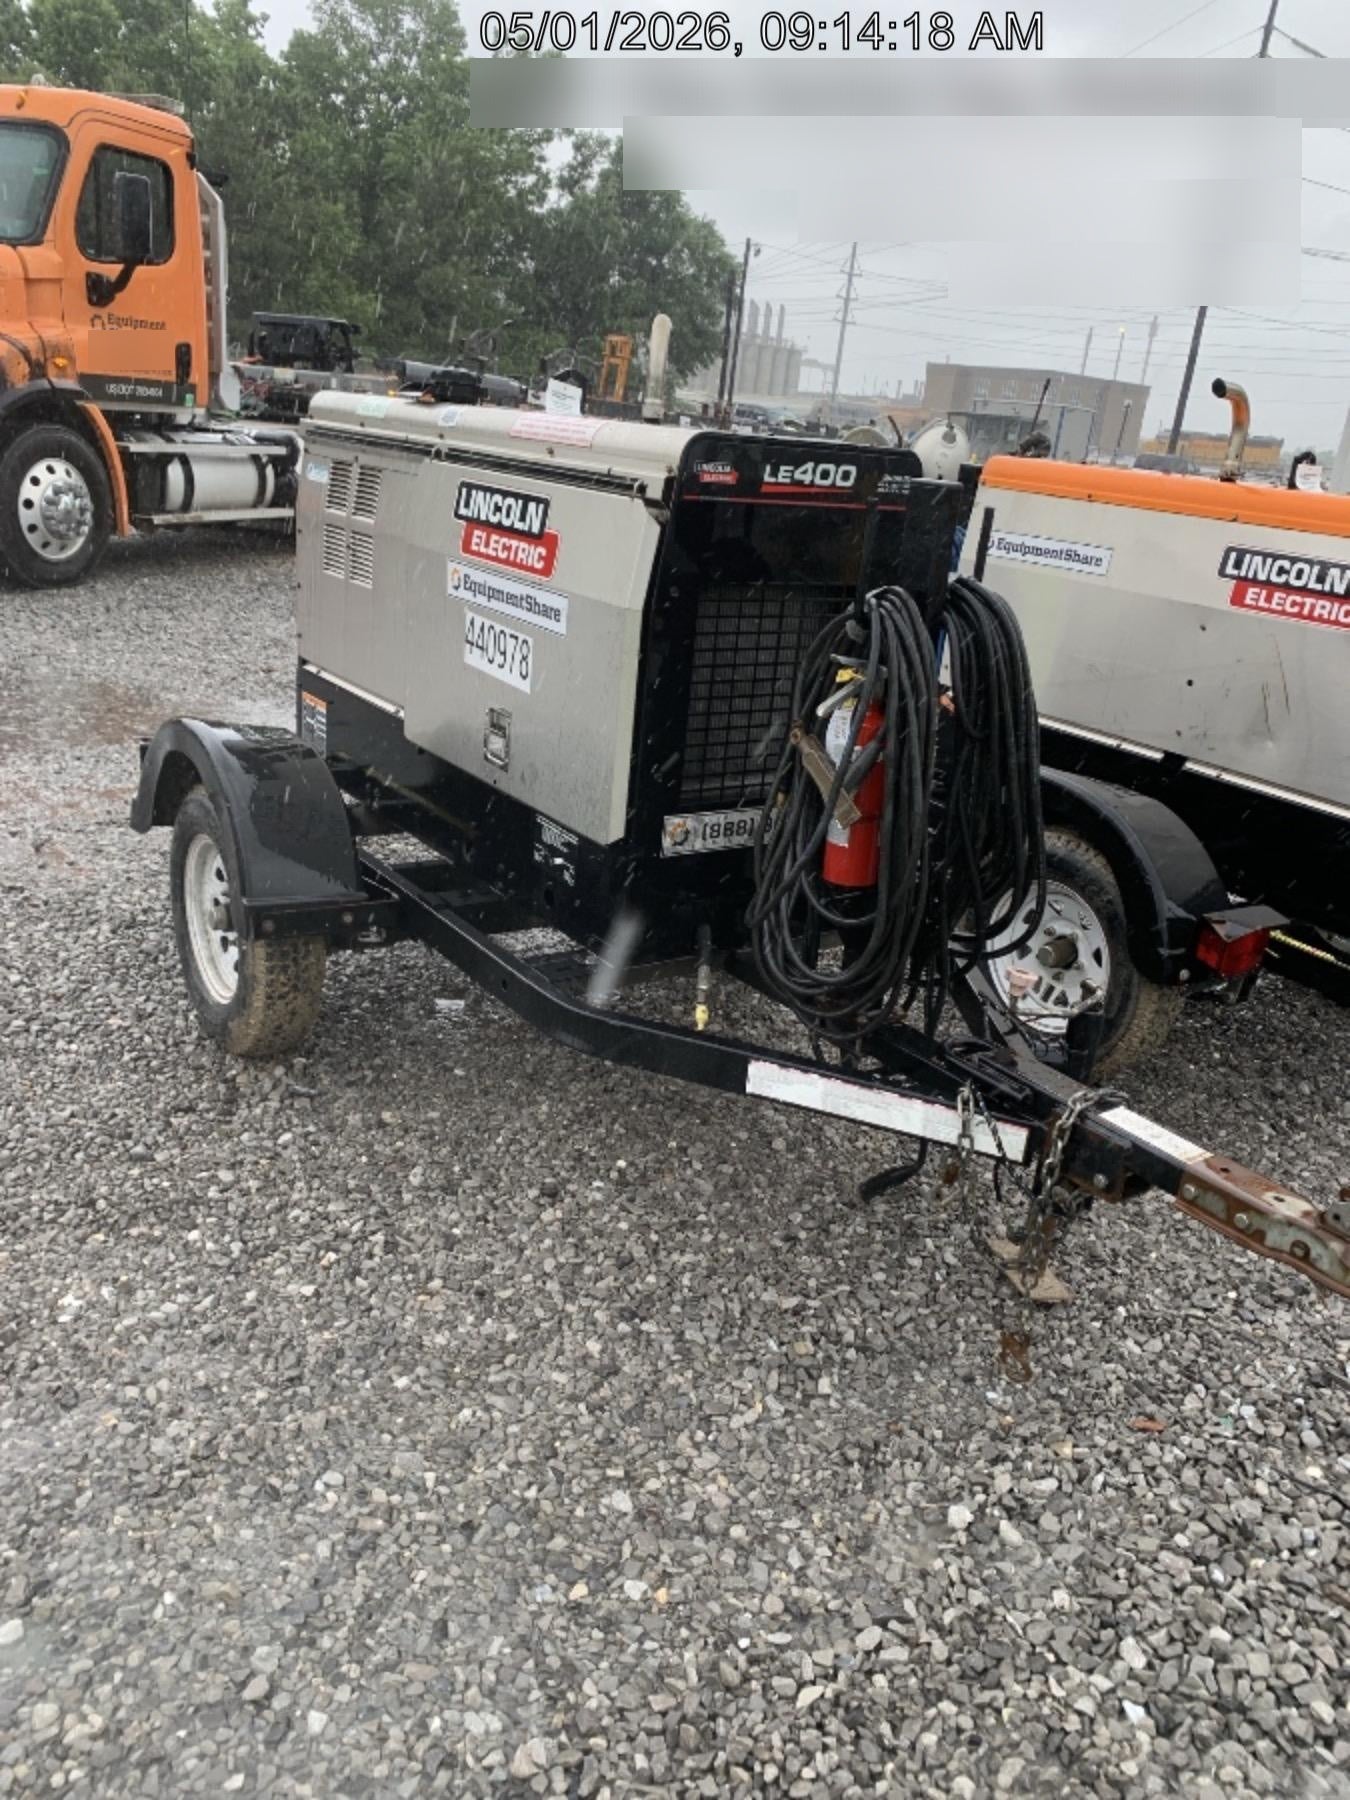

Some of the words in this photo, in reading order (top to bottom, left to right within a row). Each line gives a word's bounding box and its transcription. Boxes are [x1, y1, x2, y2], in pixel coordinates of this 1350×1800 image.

[763, 462, 857, 487] LE400
[458, 487, 544, 534] LINCOLN
[470, 529, 547, 569] ELECTRIC
[997, 537, 1103, 567] EquipmentShare
[1225, 551, 1350, 595] LINCOLN
[463, 573, 562, 622] EquipmentShare
[1244, 587, 1350, 623] ELECTRIC
[465, 615, 530, 681] 440978
